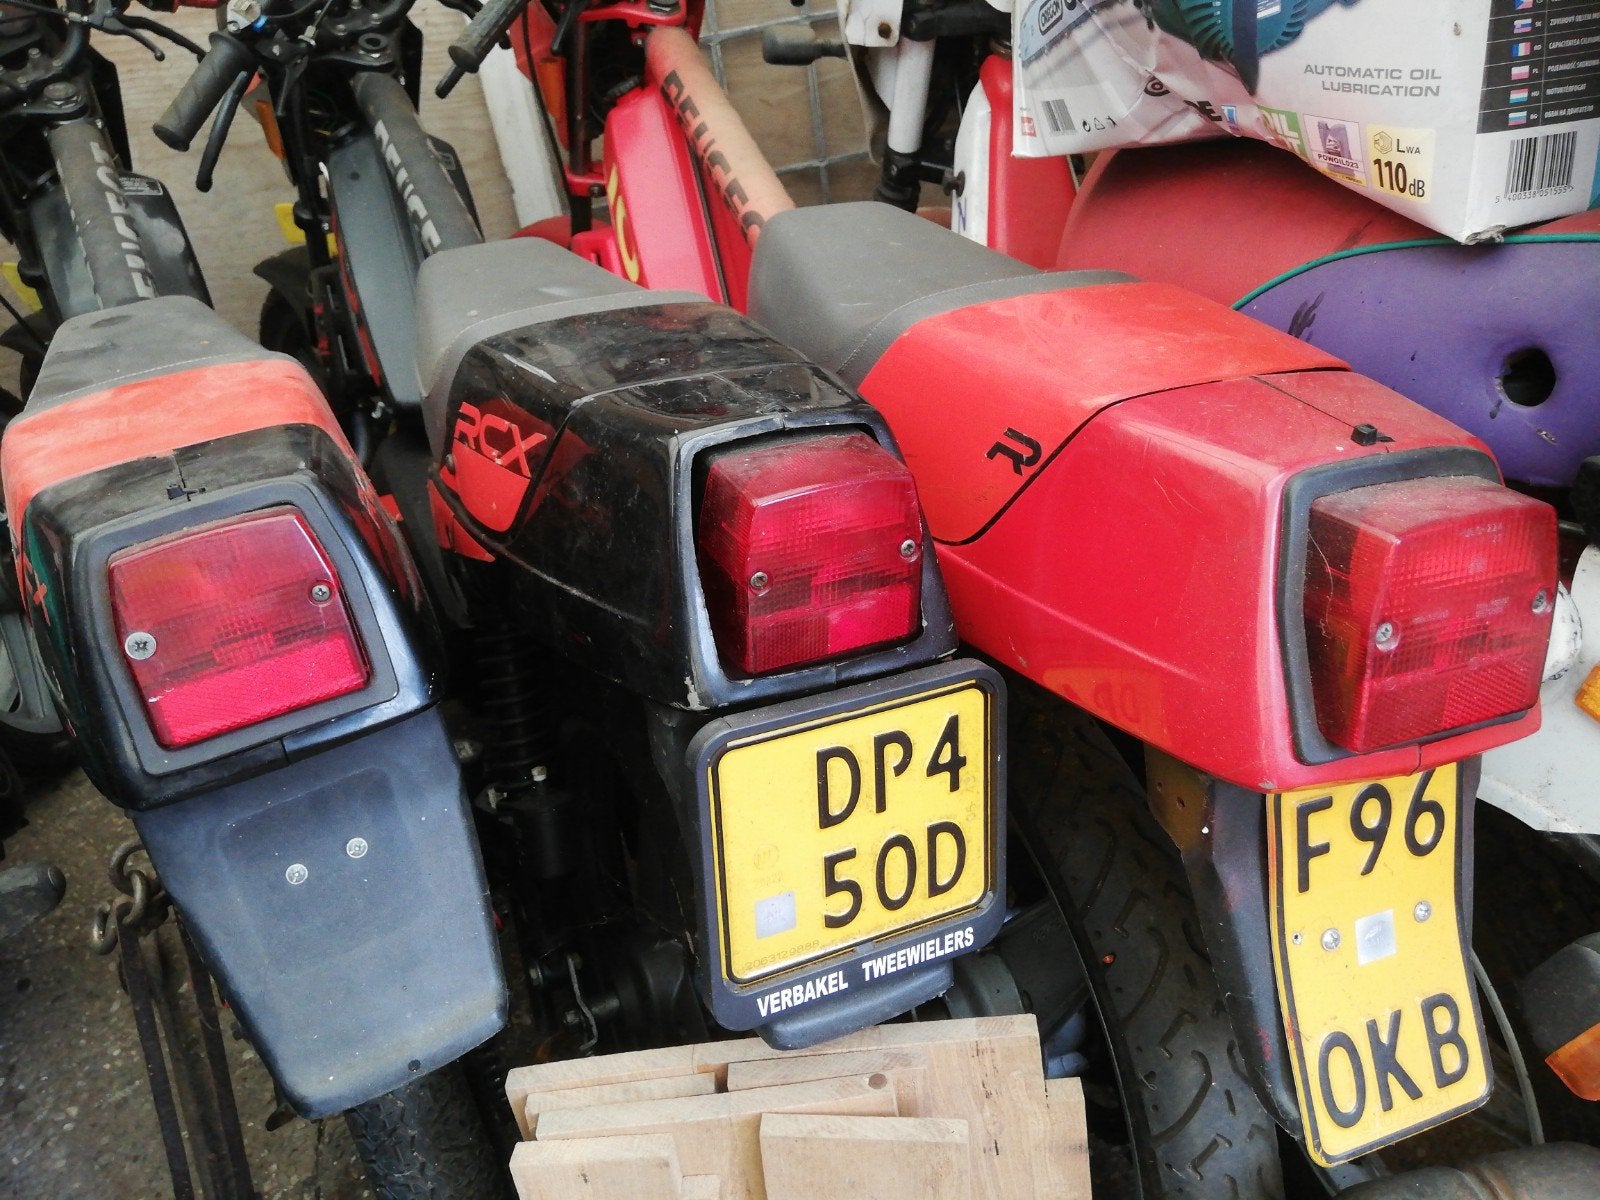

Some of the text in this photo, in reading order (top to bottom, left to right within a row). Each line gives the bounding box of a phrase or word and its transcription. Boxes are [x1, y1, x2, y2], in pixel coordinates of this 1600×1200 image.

[1304, 64, 1442, 80] AUTOMATIC OIL
[1322, 80, 1441, 97] LUBRICATION
[452, 401, 548, 479] RCX
[815, 713, 968, 830] DP4
[1296, 770, 1446, 894] F96
[756, 970, 849, 1018] VERBAKEL
[861, 926, 975, 982] TWEEWIELERS
